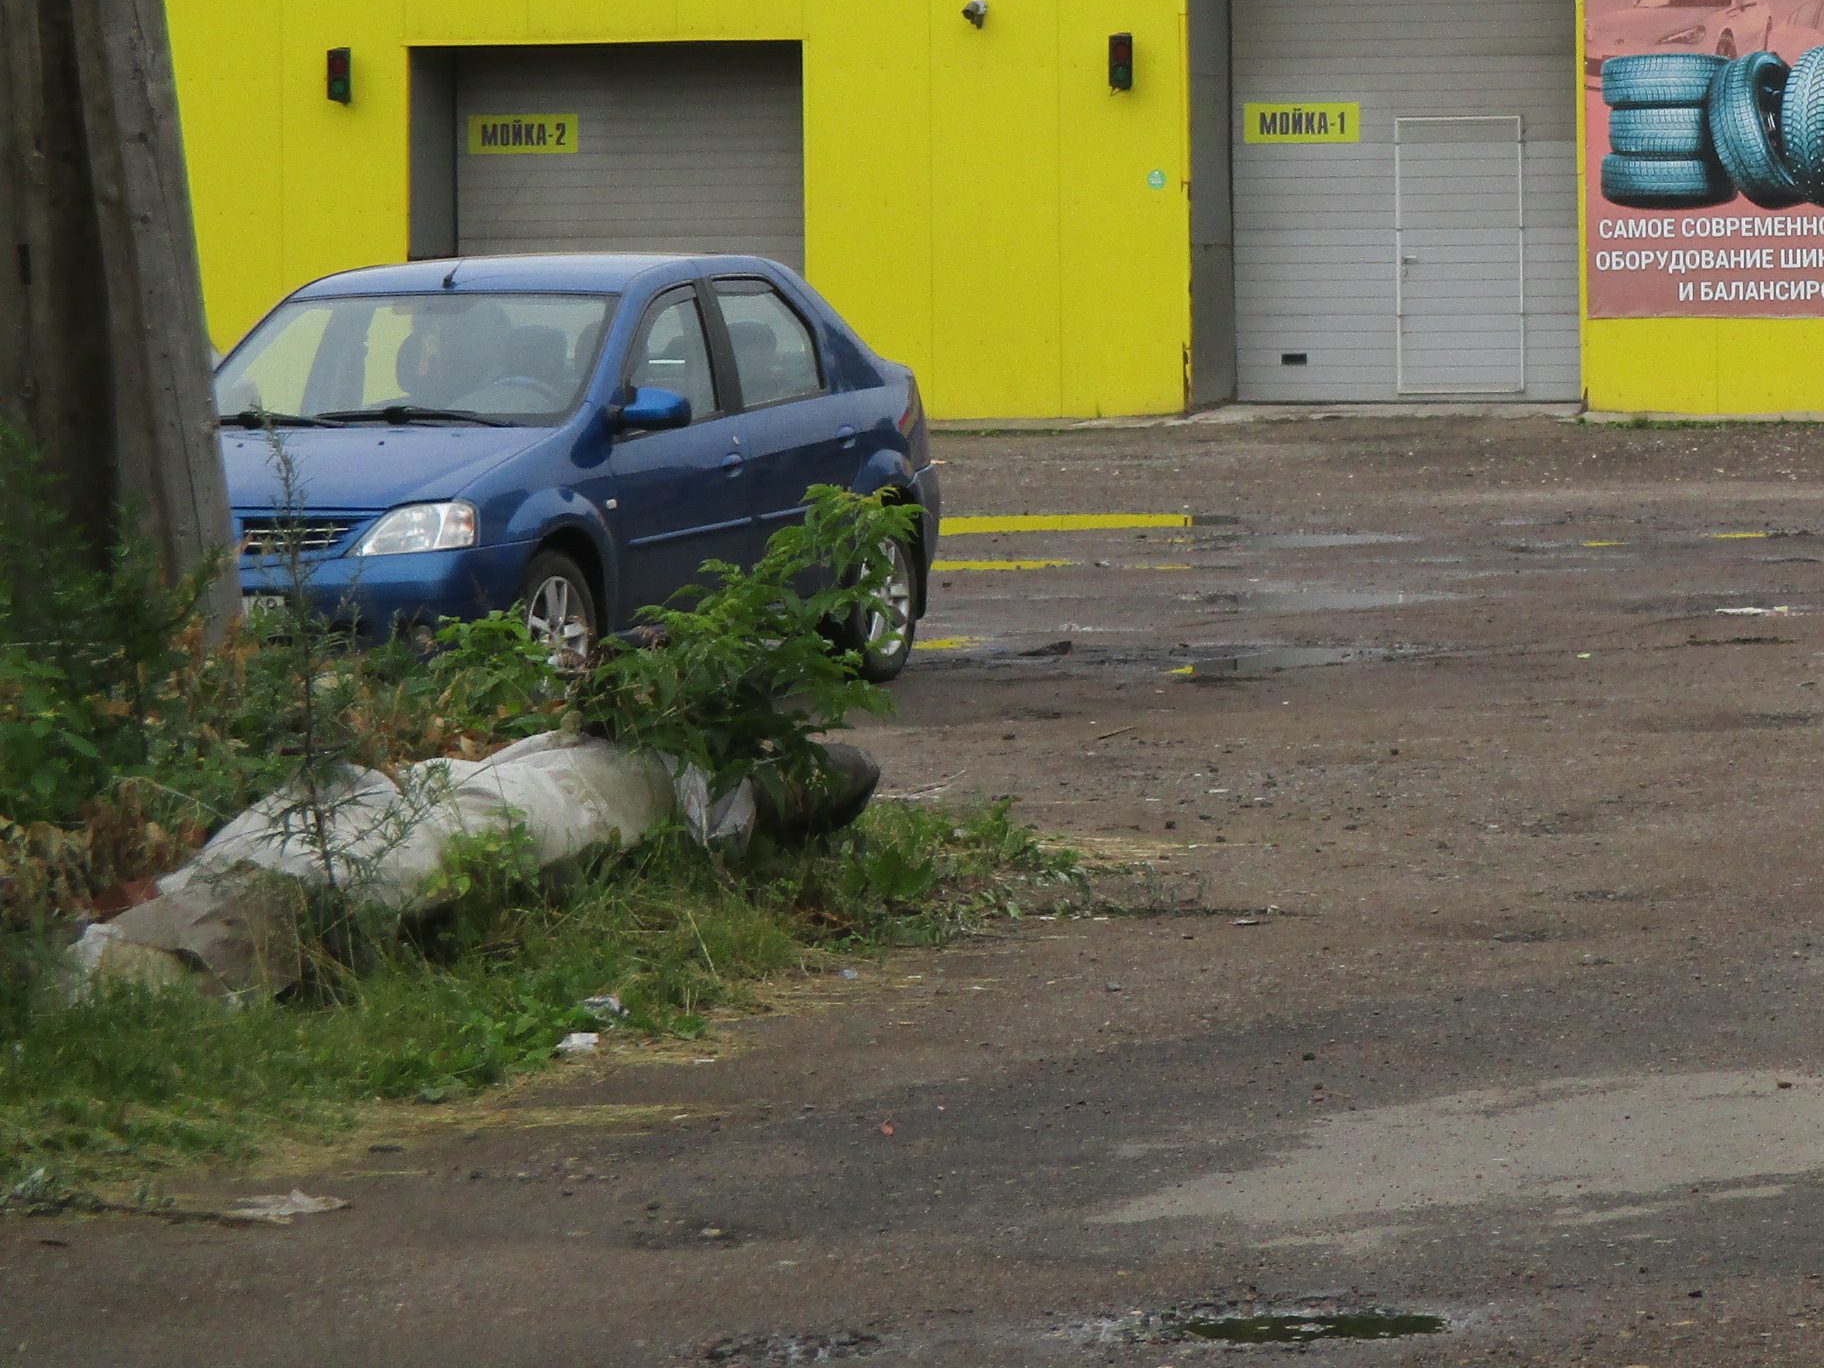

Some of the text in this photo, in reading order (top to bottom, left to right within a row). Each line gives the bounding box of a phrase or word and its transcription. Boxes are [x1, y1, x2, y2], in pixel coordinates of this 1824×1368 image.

[1599, 218, 1676, 239] САМОЕ
[1595, 249, 1775, 274] ОБОРУДОВАНИЕ
[1678, 282, 1694, 302] И
